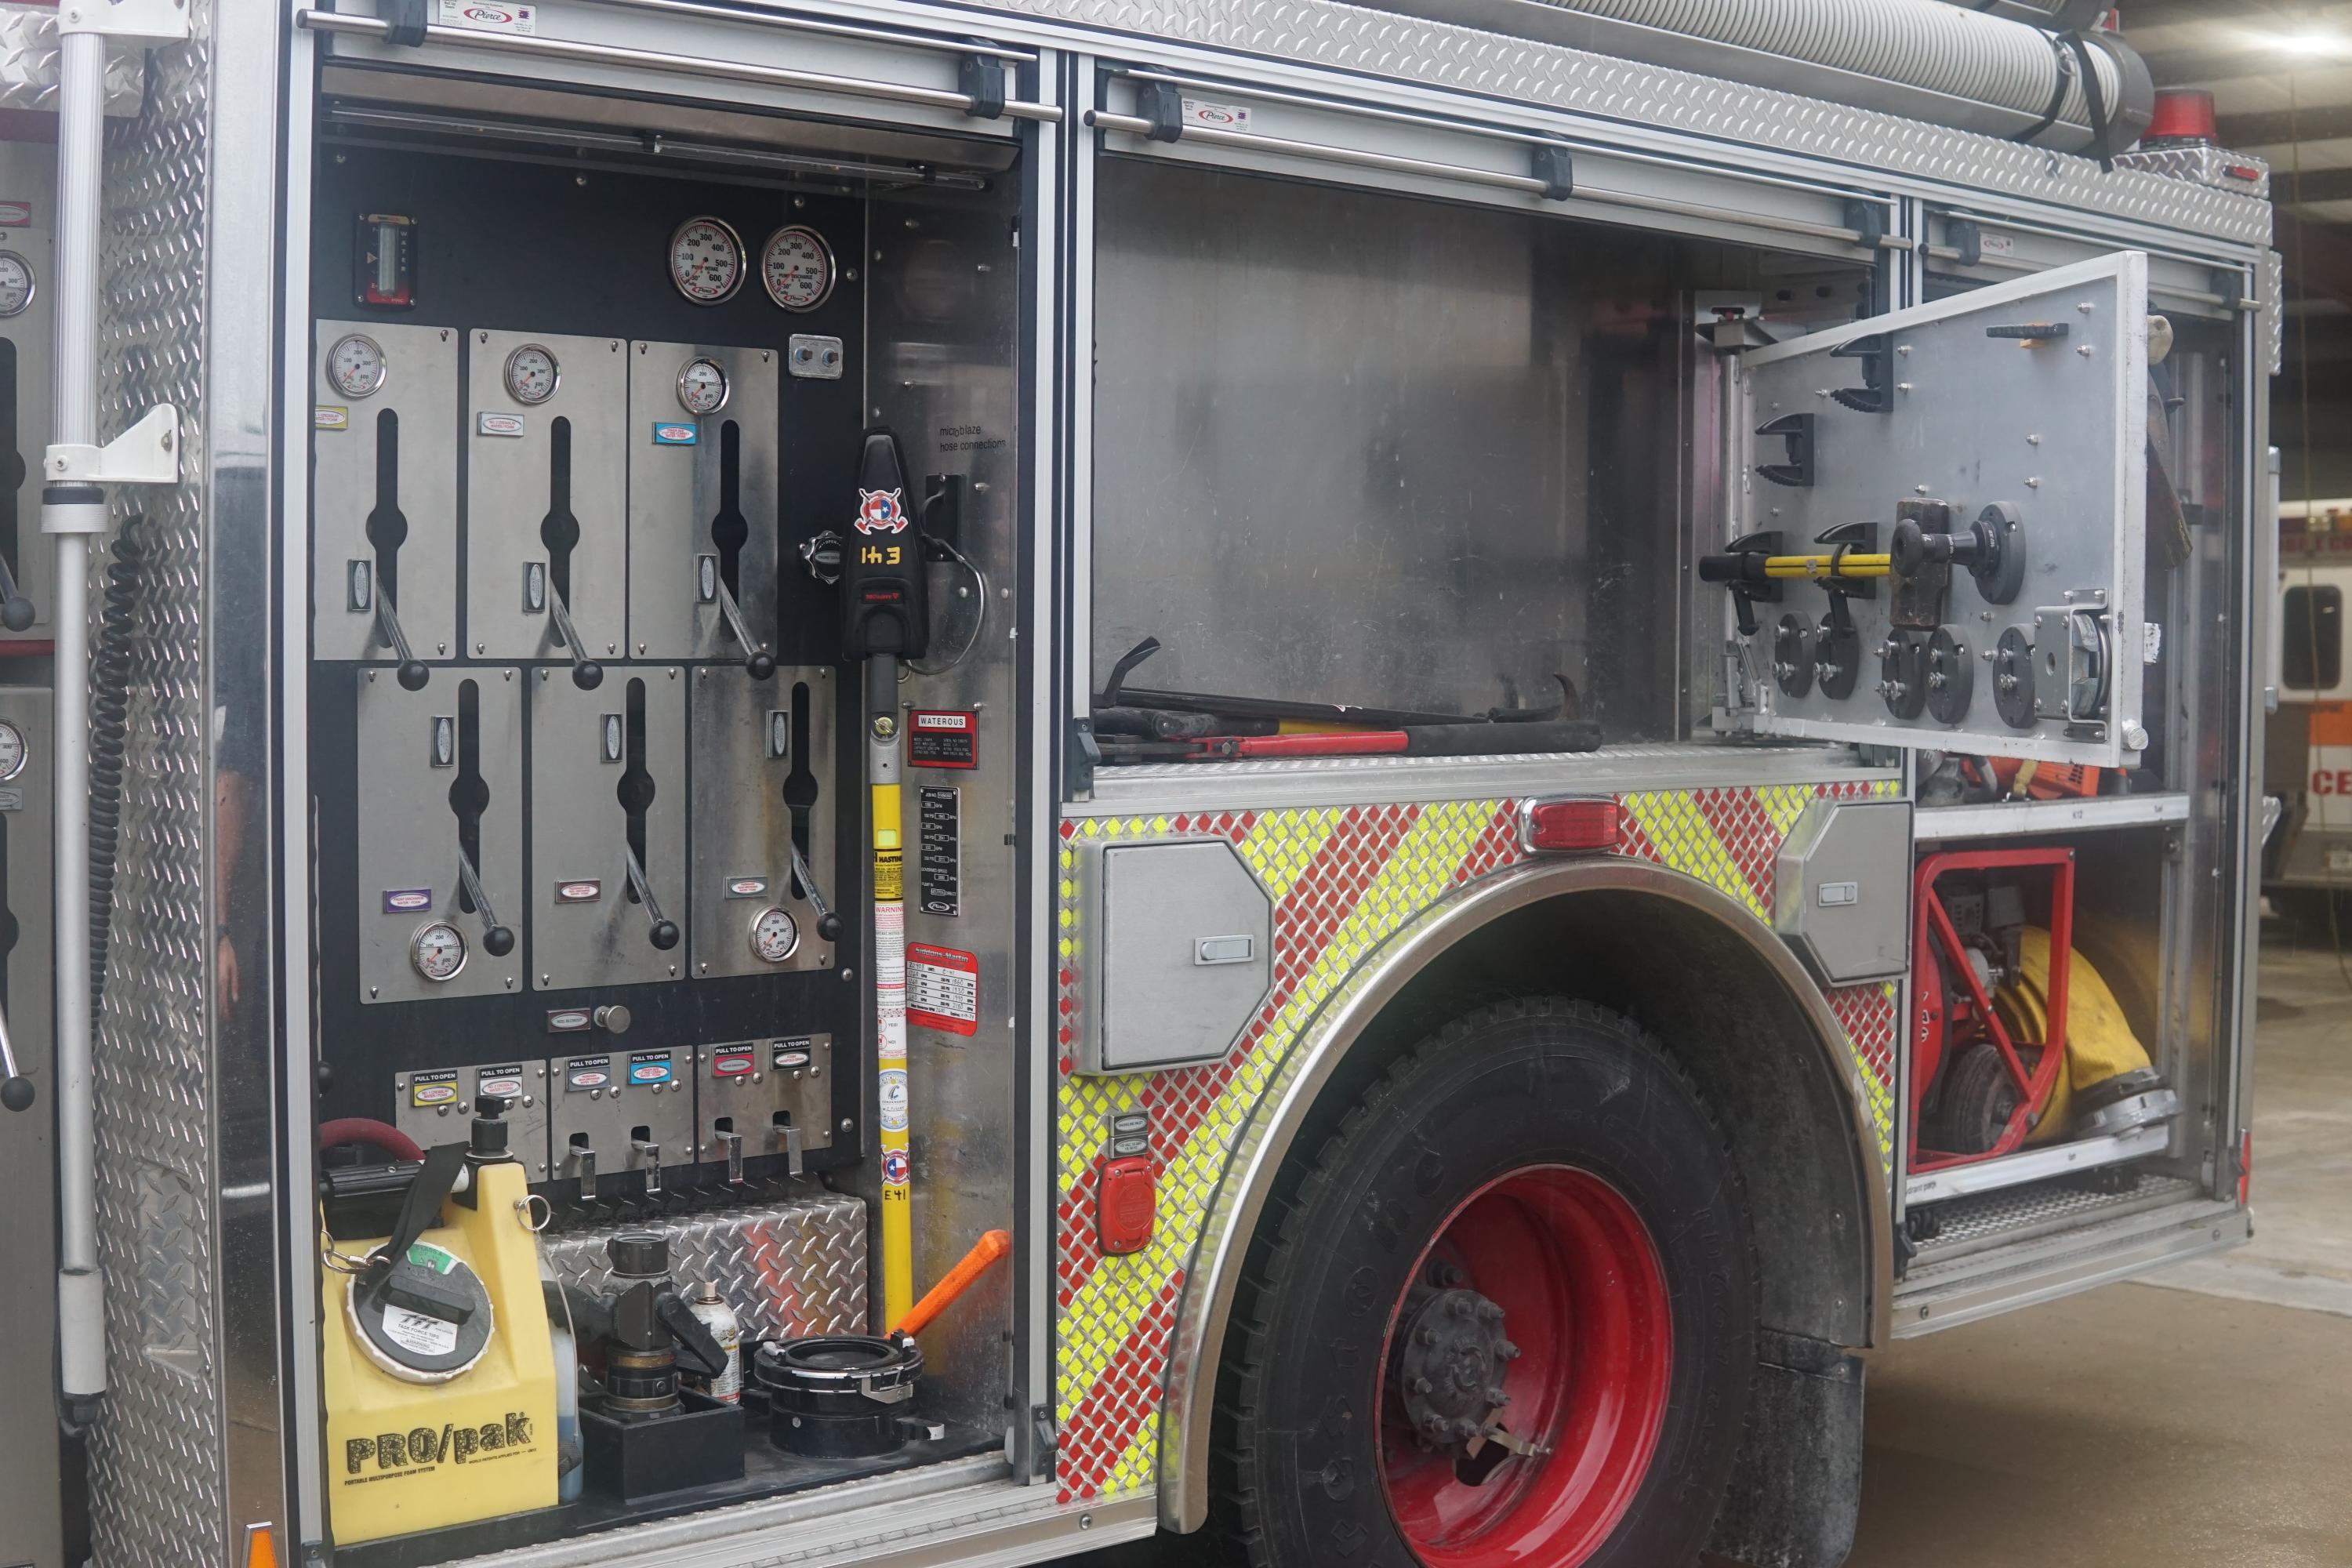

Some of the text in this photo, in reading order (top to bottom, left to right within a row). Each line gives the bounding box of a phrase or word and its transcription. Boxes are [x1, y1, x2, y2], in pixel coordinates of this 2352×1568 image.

[474, 9, 502, 20] Pierce
[1207, 111, 1225, 120] Pierce
[940, 424, 981, 437] microblaze
[940, 442, 958, 452] hose
[920, 717, 964, 726] WATEROUS
[915, 946, 969, 963] Siddons-Martin
[884, 1189, 906, 1201] E 41
[401, 1312, 441, 1330] TFT
[411, 1327, 428, 1335] FORCE
[344, 1477, 368, 1486] PORTABLE
[368, 1471, 403, 1482] MULTIPURPOSE
